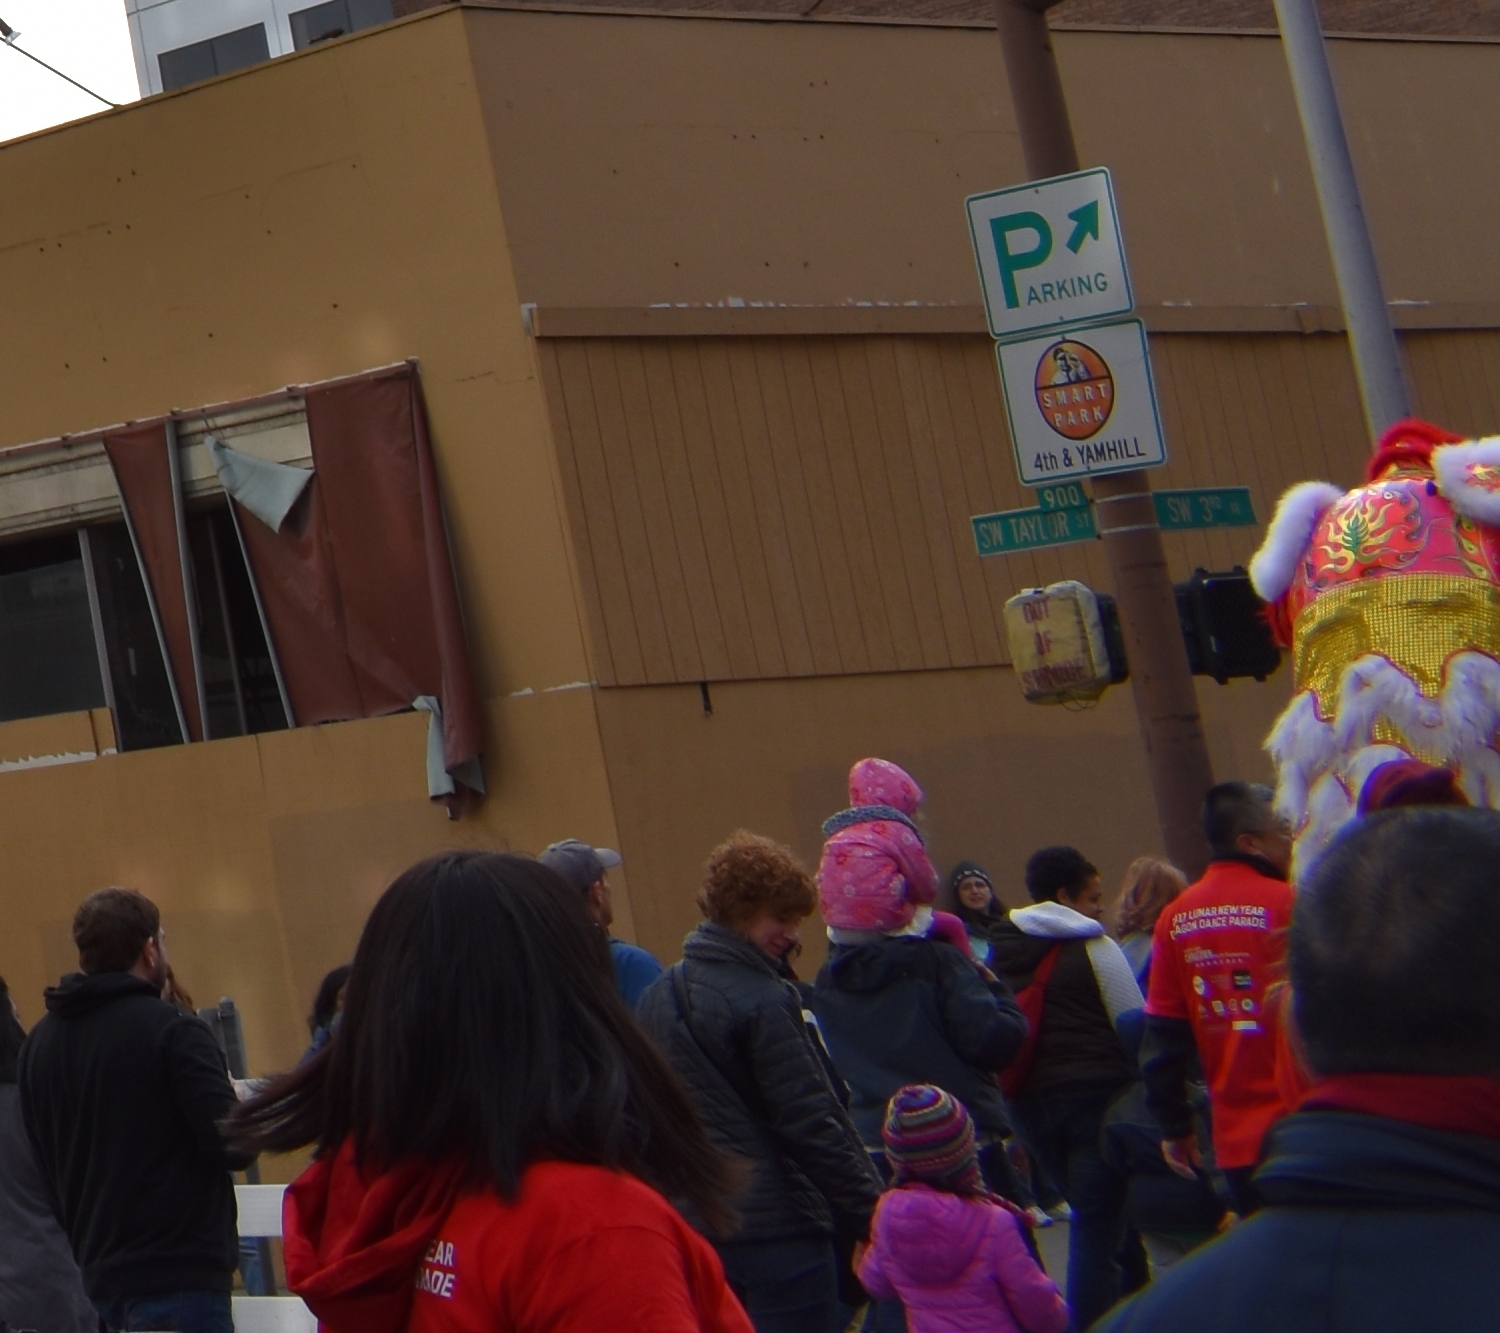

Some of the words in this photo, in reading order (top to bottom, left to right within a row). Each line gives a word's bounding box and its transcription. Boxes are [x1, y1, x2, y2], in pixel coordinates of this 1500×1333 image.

[1042, 383, 1108, 409] SMART
[1053, 406, 1105, 428] PARK
[1033, 452, 1058, 472] 4th
[1063, 449, 1073, 467] &
[1076, 437, 1146, 463] YAMHILL
[1043, 485, 1080, 508] 900
[1167, 497, 1192, 523] SW
[979, 520, 1003, 549] SW
[1008, 512, 1070, 543] TAYLOR
[1075, 513, 1090, 527] ST
[1188, 906, 1217, 920] LUNAR
[1217, 904, 1239, 915] NEW
[1240, 905, 1265, 916] YEAR
[1228, 916, 1268, 930] PARADE
[424, 1239, 454, 1267] EAR
